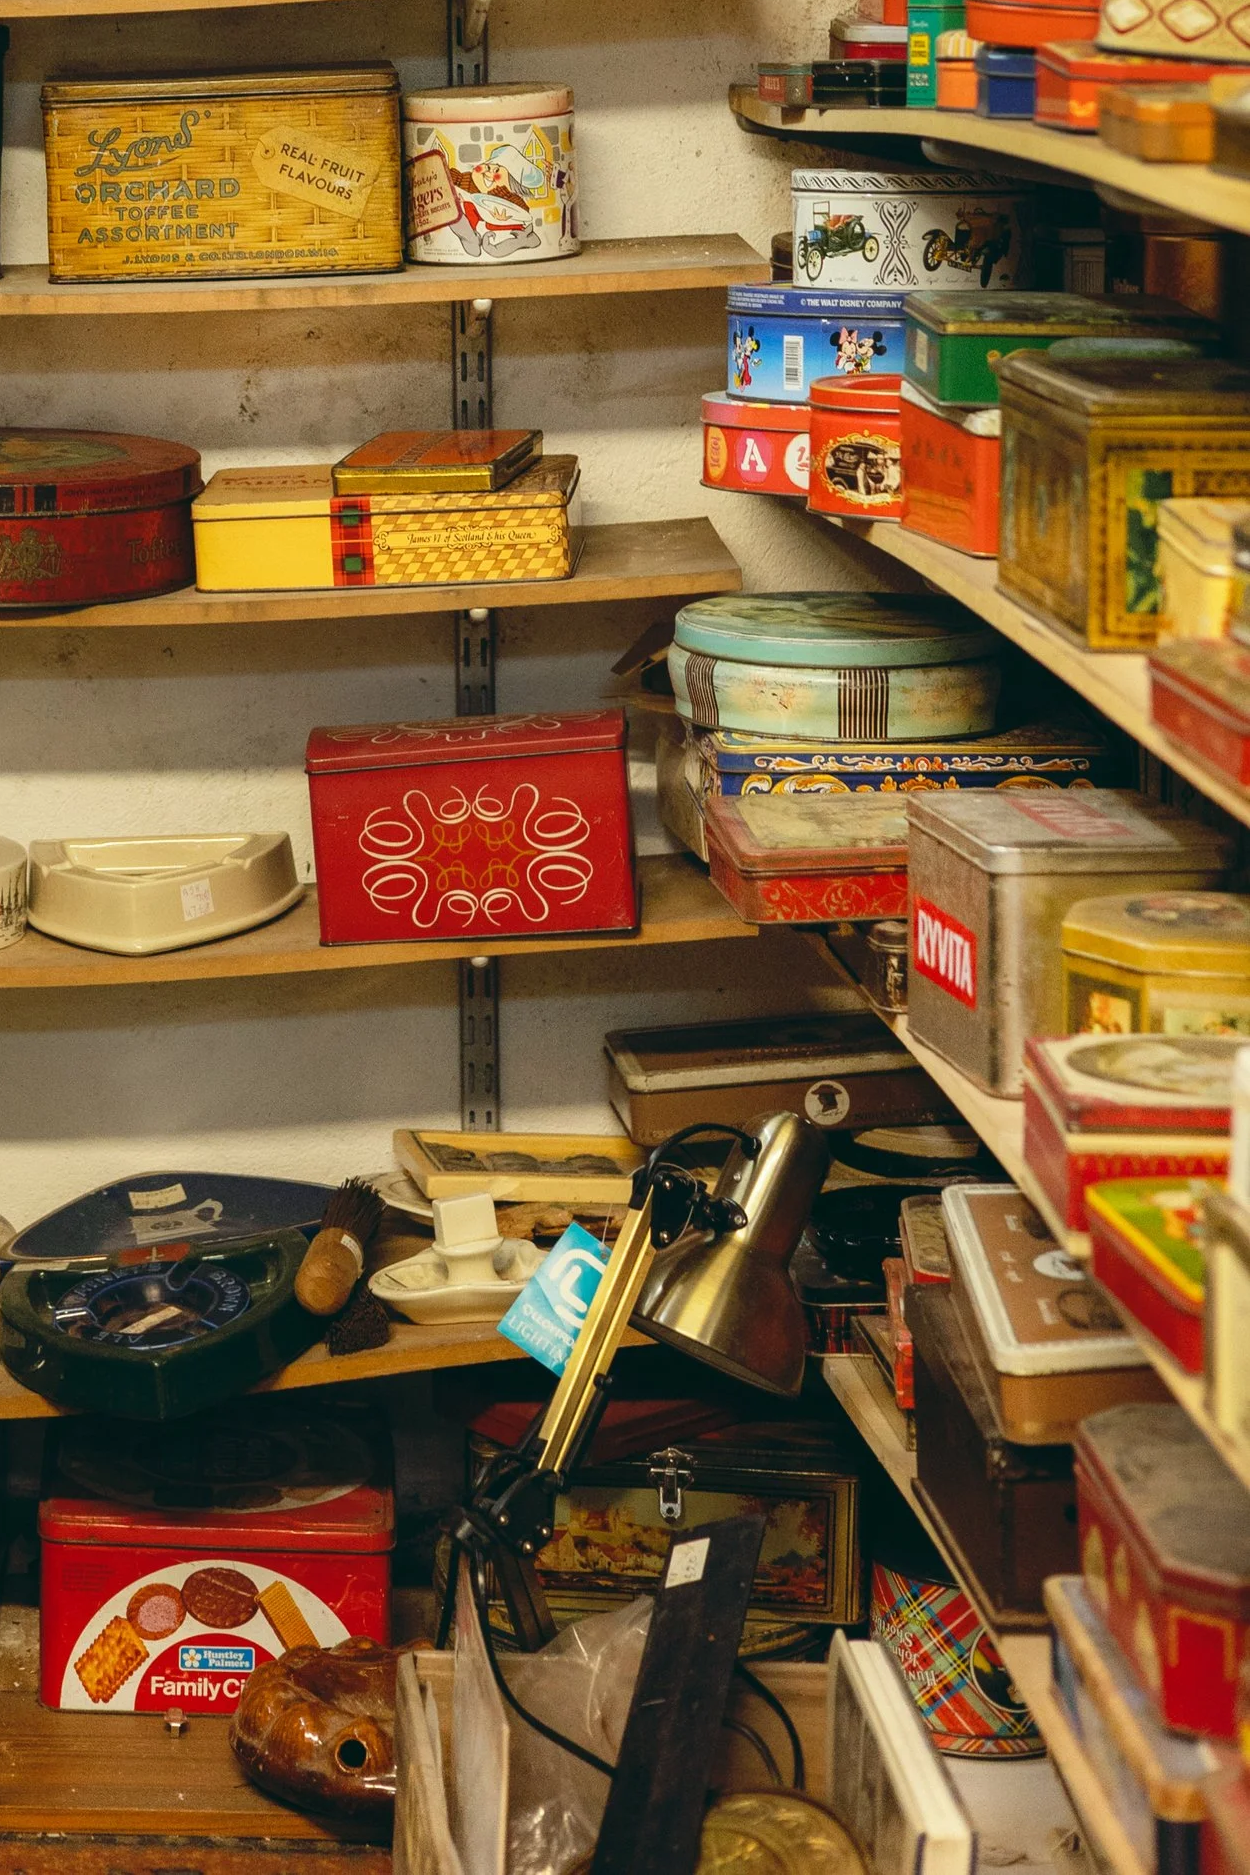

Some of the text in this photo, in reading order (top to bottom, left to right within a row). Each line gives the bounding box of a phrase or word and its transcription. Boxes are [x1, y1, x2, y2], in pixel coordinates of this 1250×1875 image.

[278, 163, 354, 201] FLAVOURS
[320, 157, 366, 184] FRUIT
[74, 177, 241, 204] ORCHARD
[112, 204, 200, 222] TOFFEE
[77, 222, 240, 245] ASSORTMENT
[184, 252, 196, 262] &
[806, 297, 902, 309] THE WALT DISNEY COMPANY
[740, 437, 767, 473] A
[406, 531, 433, 545] James
[432, 531, 442, 544] VI
[442, 530, 452, 544] of
[452, 529, 486, 543] Scotland
[494, 529, 506, 541] his
[506, 528, 537, 541] Queen
[917, 908, 974, 998] RYVITA
[211, 1270, 242, 1313] BROWN
[203, 1650, 245, 1661] Huntley
[208, 1657, 250, 1668] Palmers
[150, 1675, 222, 1702] Family
